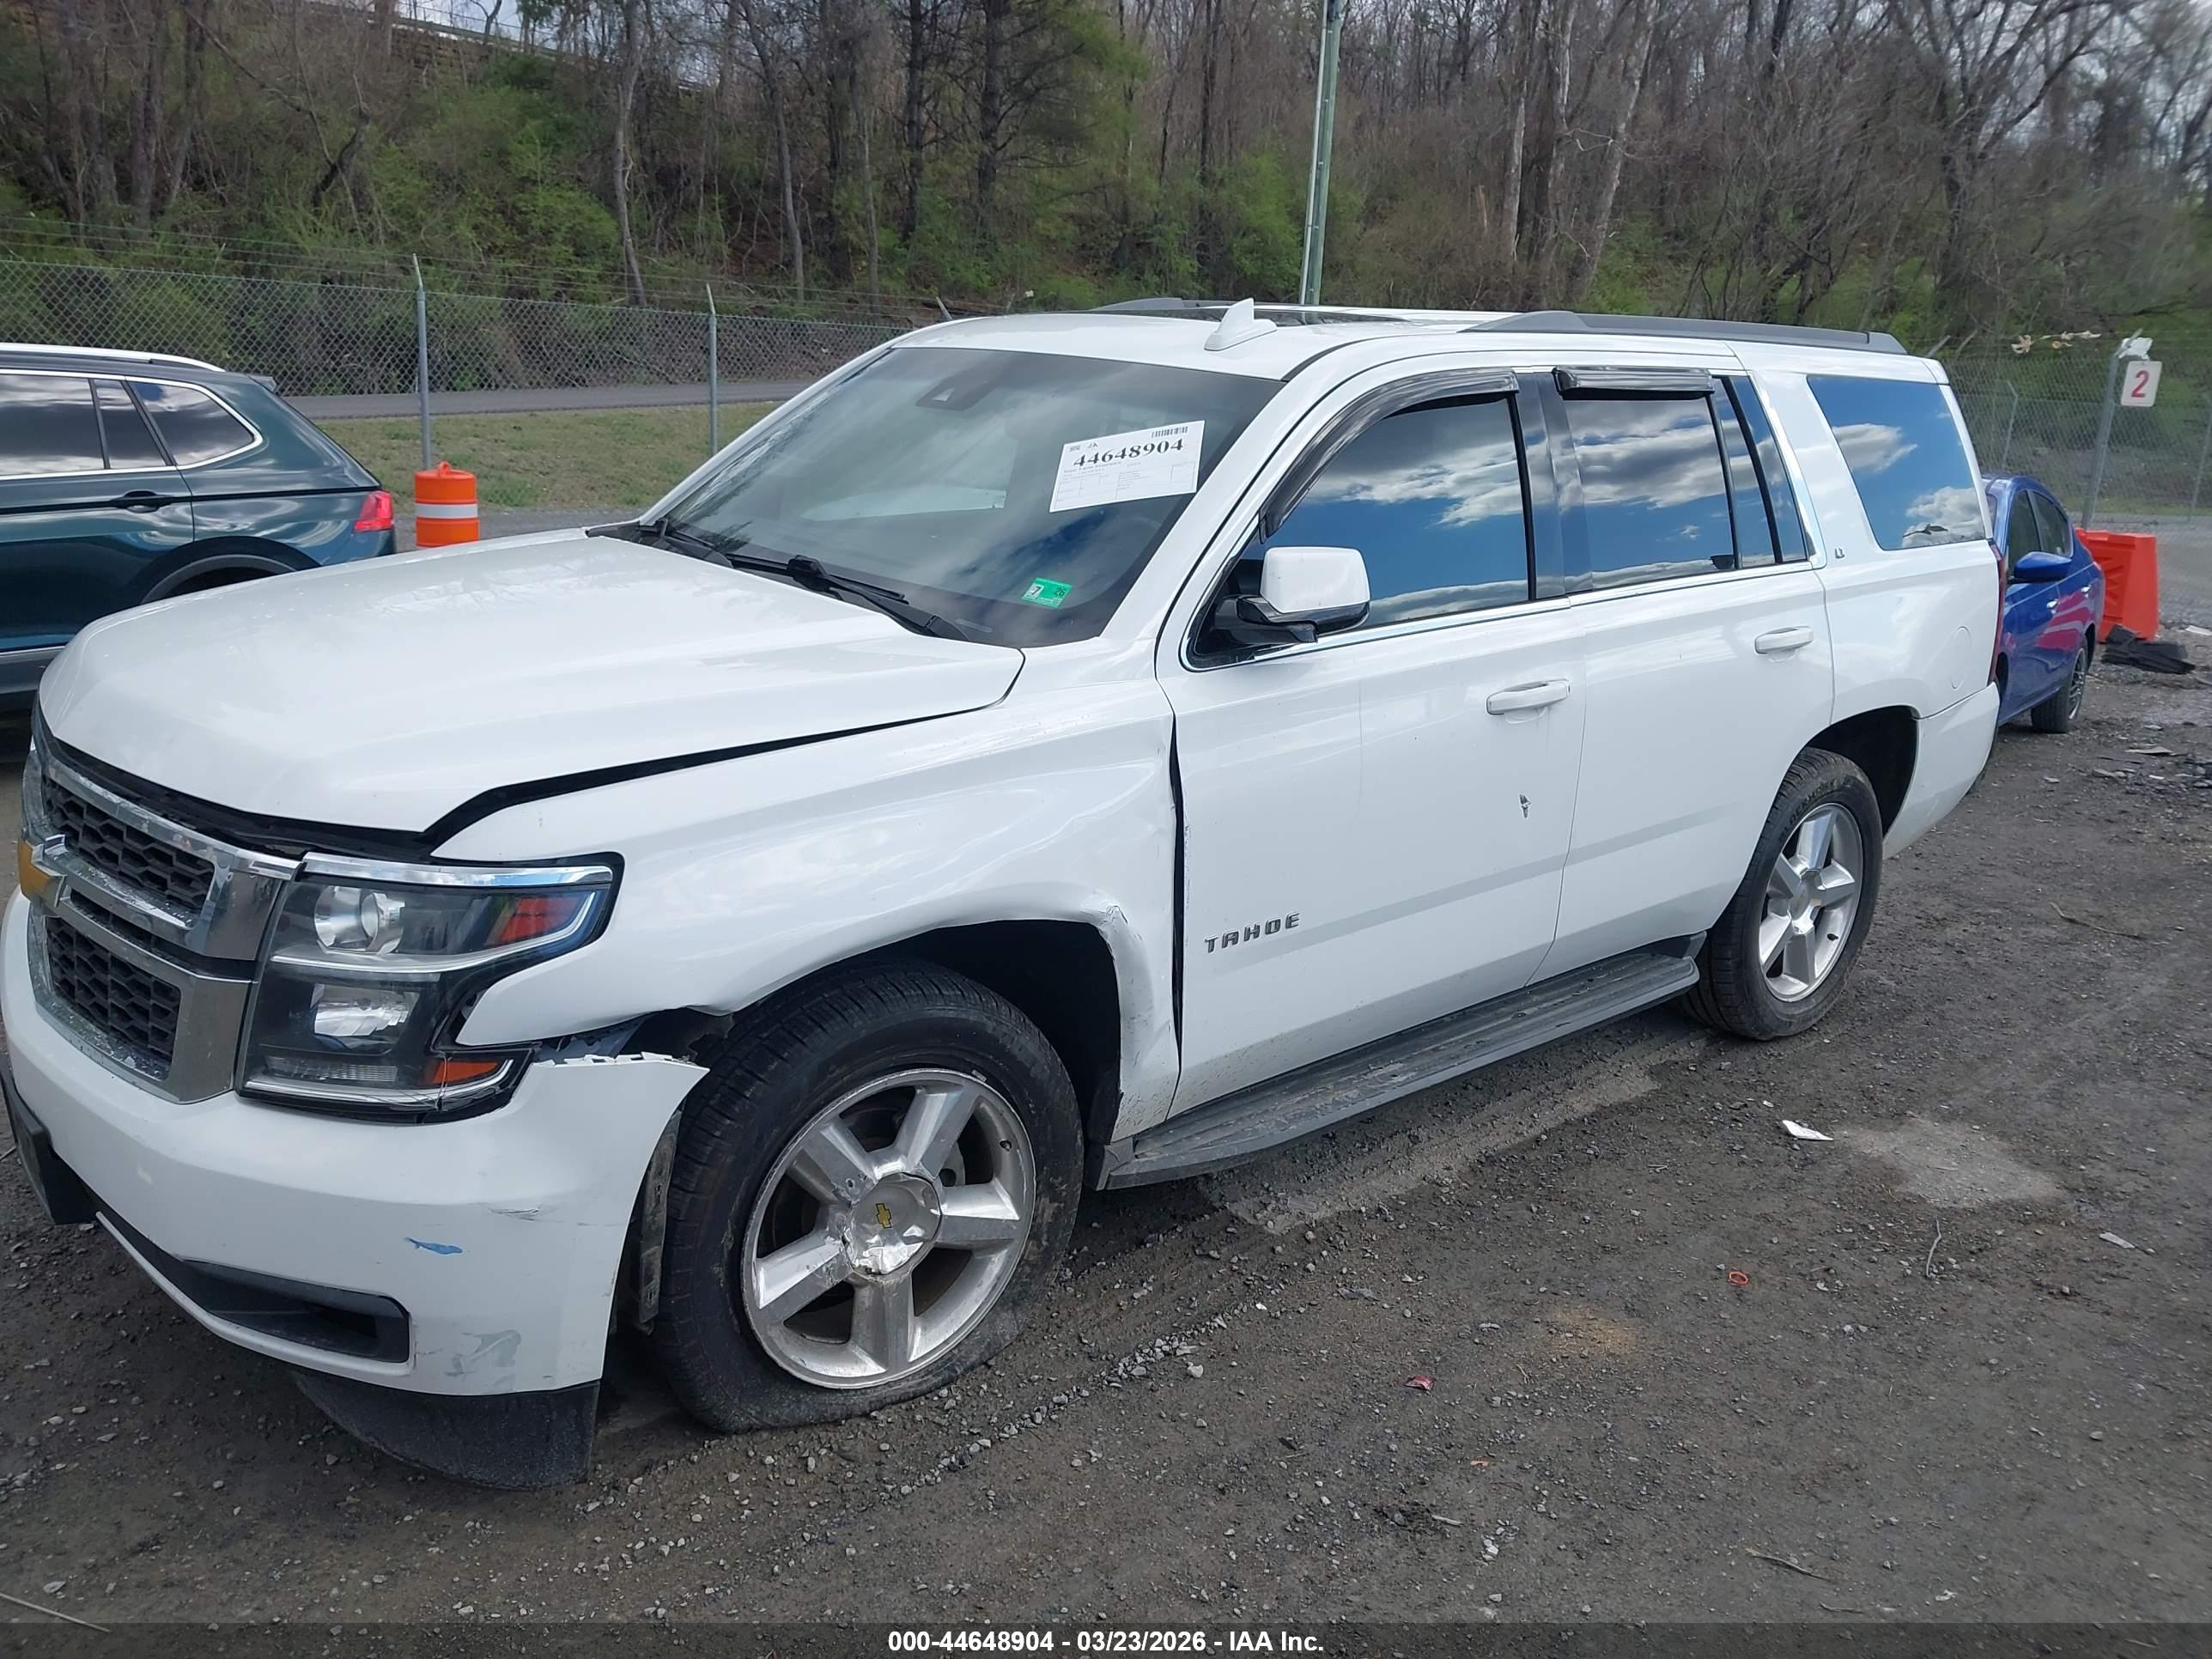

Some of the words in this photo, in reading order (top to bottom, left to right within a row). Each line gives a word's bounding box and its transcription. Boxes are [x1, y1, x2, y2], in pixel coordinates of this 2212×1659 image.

[2130, 369, 2150, 398] 2
[1073, 438, 1184, 467] 44648904
[1030, 586, 1042, 596] 7
[1054, 586, 1066, 597] 26
[1204, 912, 1301, 954] TAHOE
